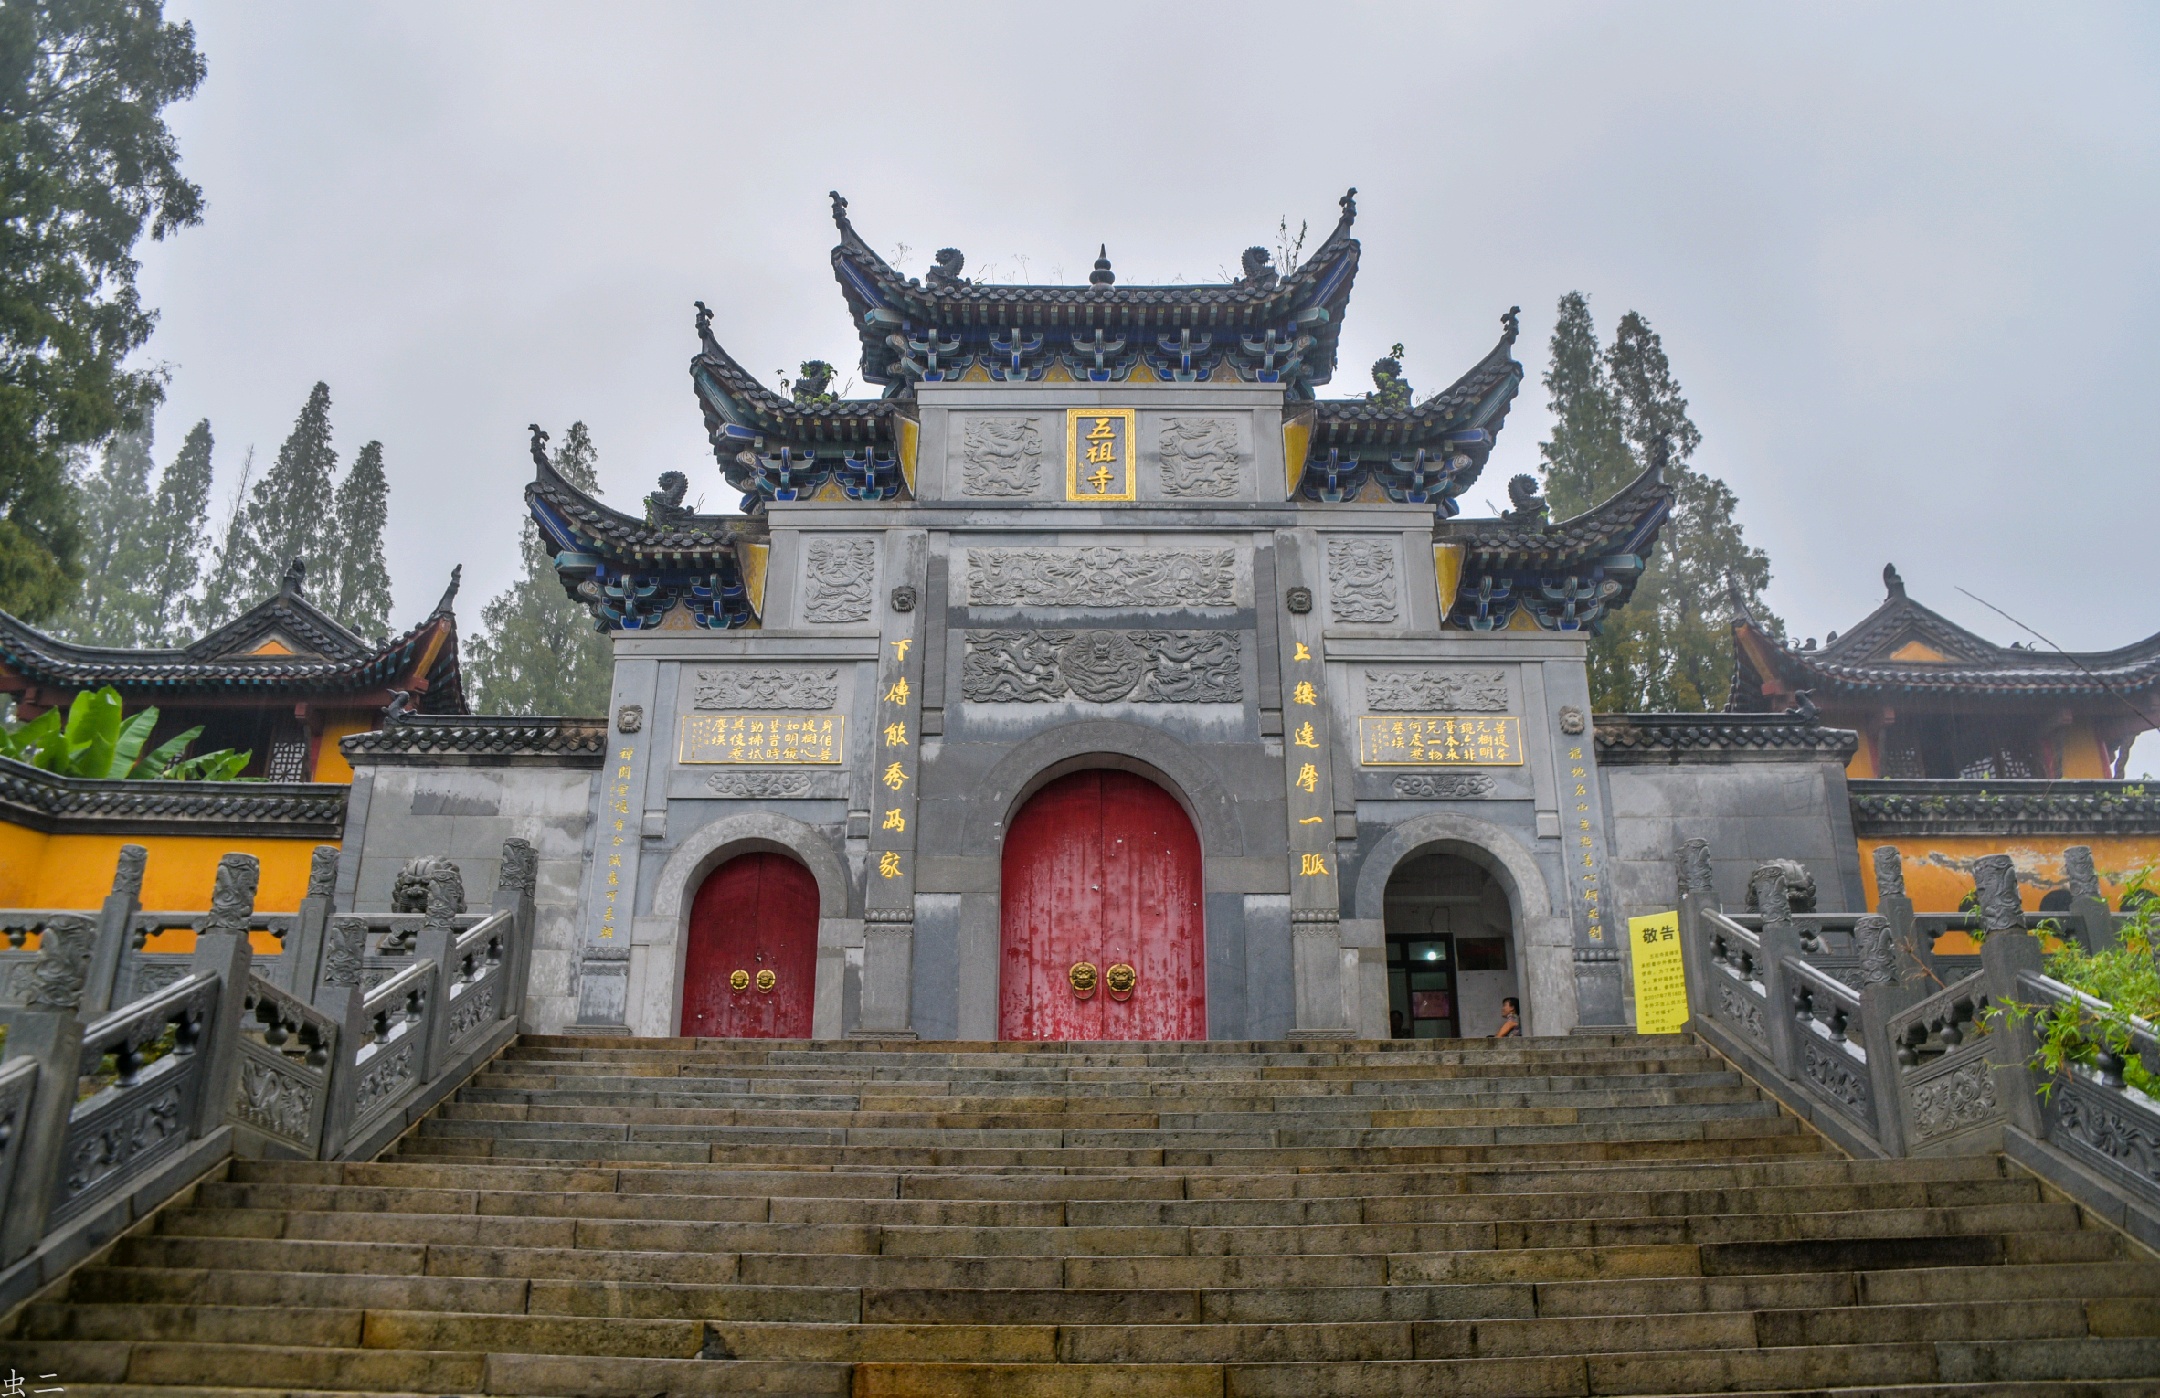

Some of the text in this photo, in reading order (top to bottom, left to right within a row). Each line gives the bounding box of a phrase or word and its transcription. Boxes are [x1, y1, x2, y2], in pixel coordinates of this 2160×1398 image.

[1085, 417, 1117, 495] 五祖寺
[1642, 925, 1675, 944] 敬告
